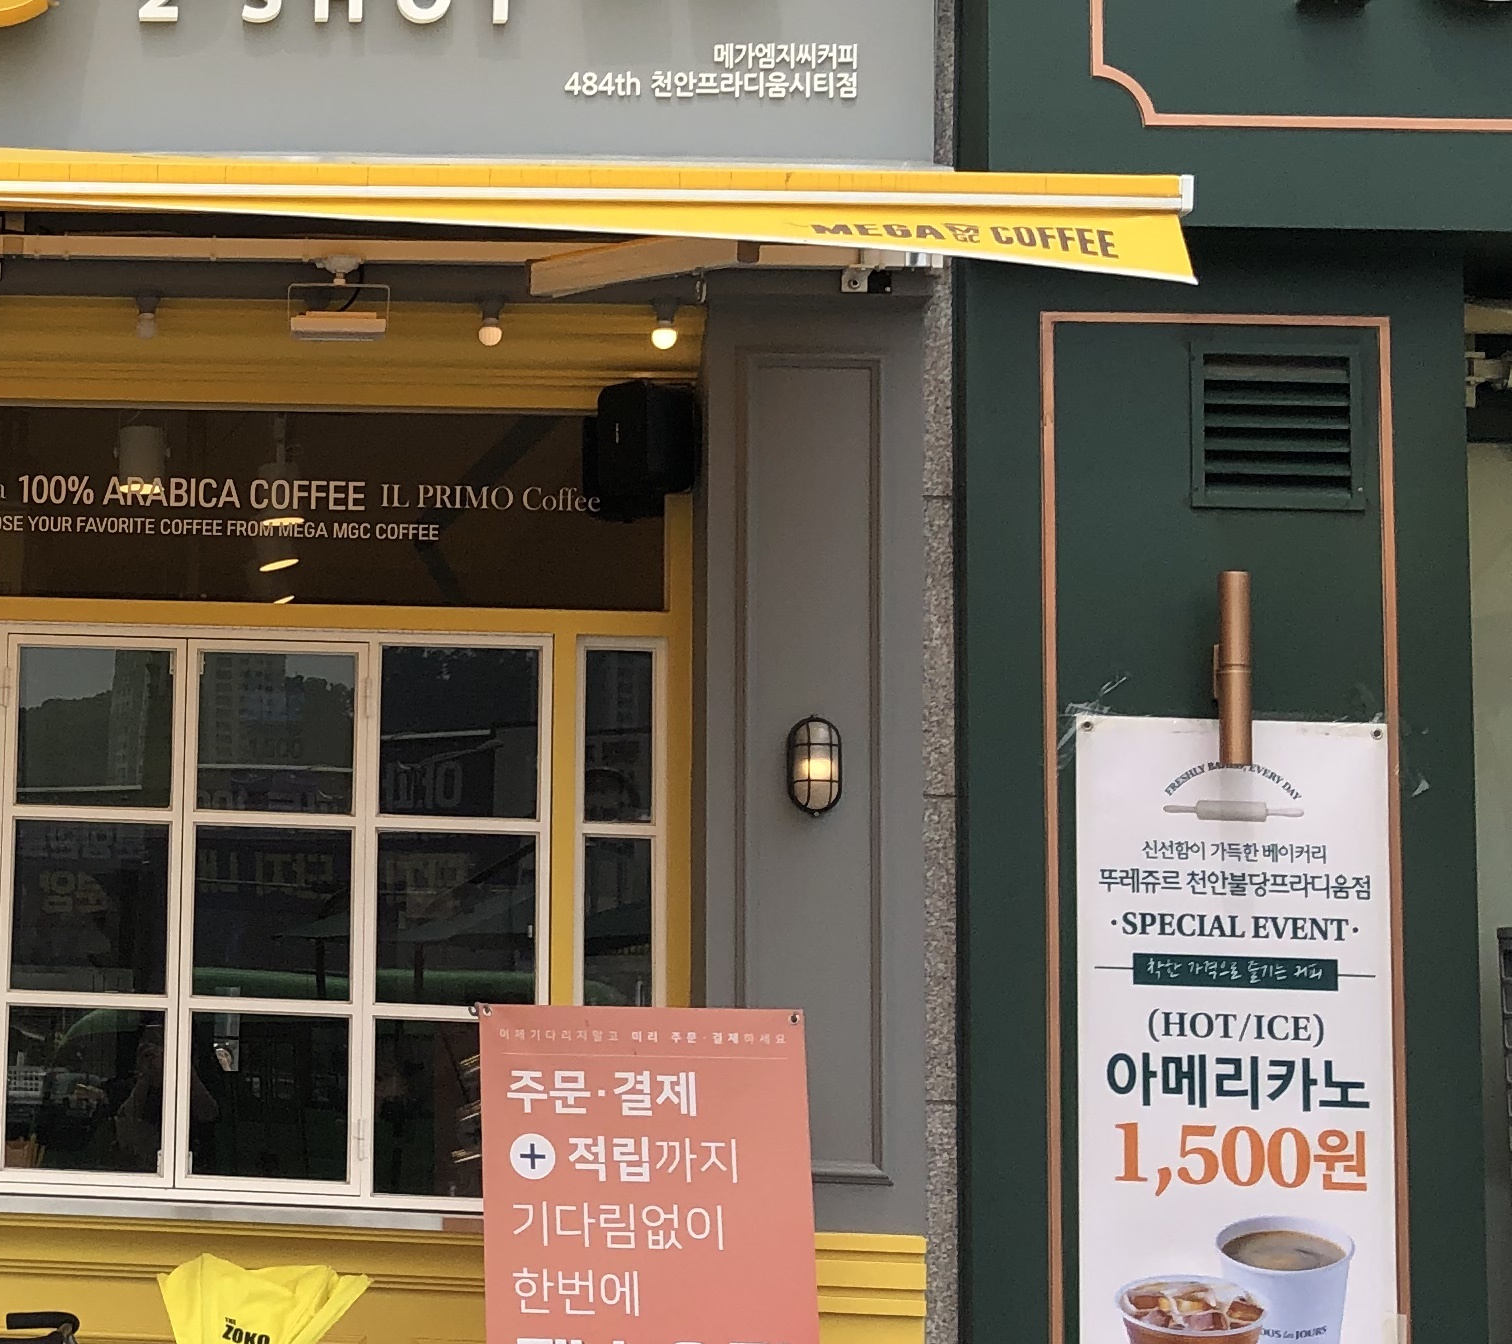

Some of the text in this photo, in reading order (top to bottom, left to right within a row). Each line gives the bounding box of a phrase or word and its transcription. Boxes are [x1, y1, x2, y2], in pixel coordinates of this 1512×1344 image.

[713, 42, 859, 69] 메가엠지씨커피
[564, 70, 859, 99] 484th 천안프라디움시티점
[811, 223, 946, 241] MEGA
[990, 226, 1119, 260] COFFEE
[18, 474, 95, 506] 100%
[103, 475, 241, 509] ARABICA
[250, 478, 366, 512] COFFEE
[380, 483, 410, 509] IL
[417, 484, 514, 512] PRIMO
[523, 486, 601, 513] Coffee
[27, 515, 73, 533] YOUR
[76, 516, 156, 535] FAVORITE
[160, 518, 223, 537] COFFEE
[226, 520, 275, 538] FROM
[278, 521, 328, 539] MEGA
[333, 522, 372, 540] MGC
[376, 523, 440, 542] COFFEE
[1164, 763, 1206, 797] FRESHLY
[1249, 764, 1284, 785] EVERY
[1281, 781, 1303, 801] DAY
[1141, 840, 1328, 865] 신선함이 가득한 베이커리
[1098, 868, 1372, 901] 뚜레쥬르 천안불당프라디움점
[1122, 911, 1350, 942] SPECIAL EVENT
[1146, 958, 1325, 983] 착한 가격으로 즐기는 커피
[631, 1030, 659, 1043] 미리
[1147, 1008, 1326, 1047] (HOT/ICE)
[506, 1069, 698, 1117] 주문·결제
[1107, 1052, 1370, 1113] 아메리카노
[568, 1134, 739, 1184] 적립까지
[1115, 1121, 1369, 1199] 1,500원
[512, 1201, 725, 1251] 기다림없이
[512, 1267, 641, 1317] 한번에
